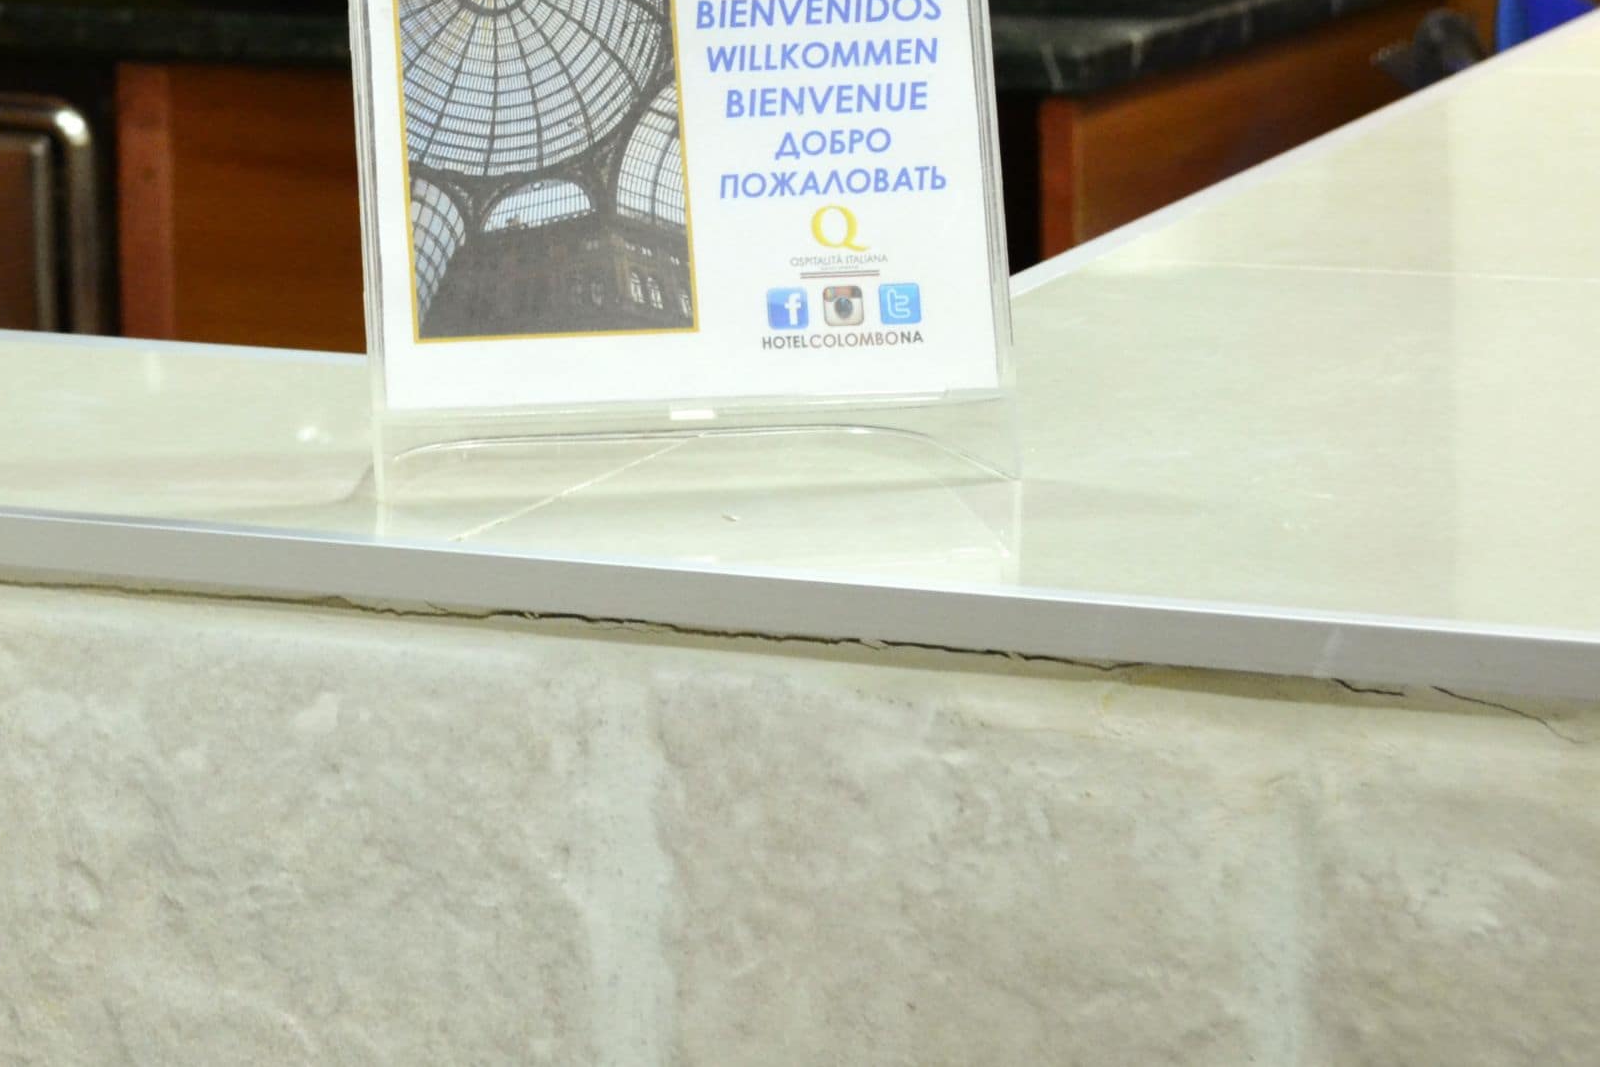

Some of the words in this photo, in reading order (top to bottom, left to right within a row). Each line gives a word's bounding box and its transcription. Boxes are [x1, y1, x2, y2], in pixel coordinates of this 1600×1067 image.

[706, 38, 938, 73] WILLKOMMEN
[725, 81, 928, 118] BIENVENUE
[774, 127, 892, 160] ДОБРО
[719, 166, 947, 199] ПОЖАЛОВАТЬ
[811, 204, 870, 252] Q
[762, 330, 924, 350] HOTELCOLOMBONA
